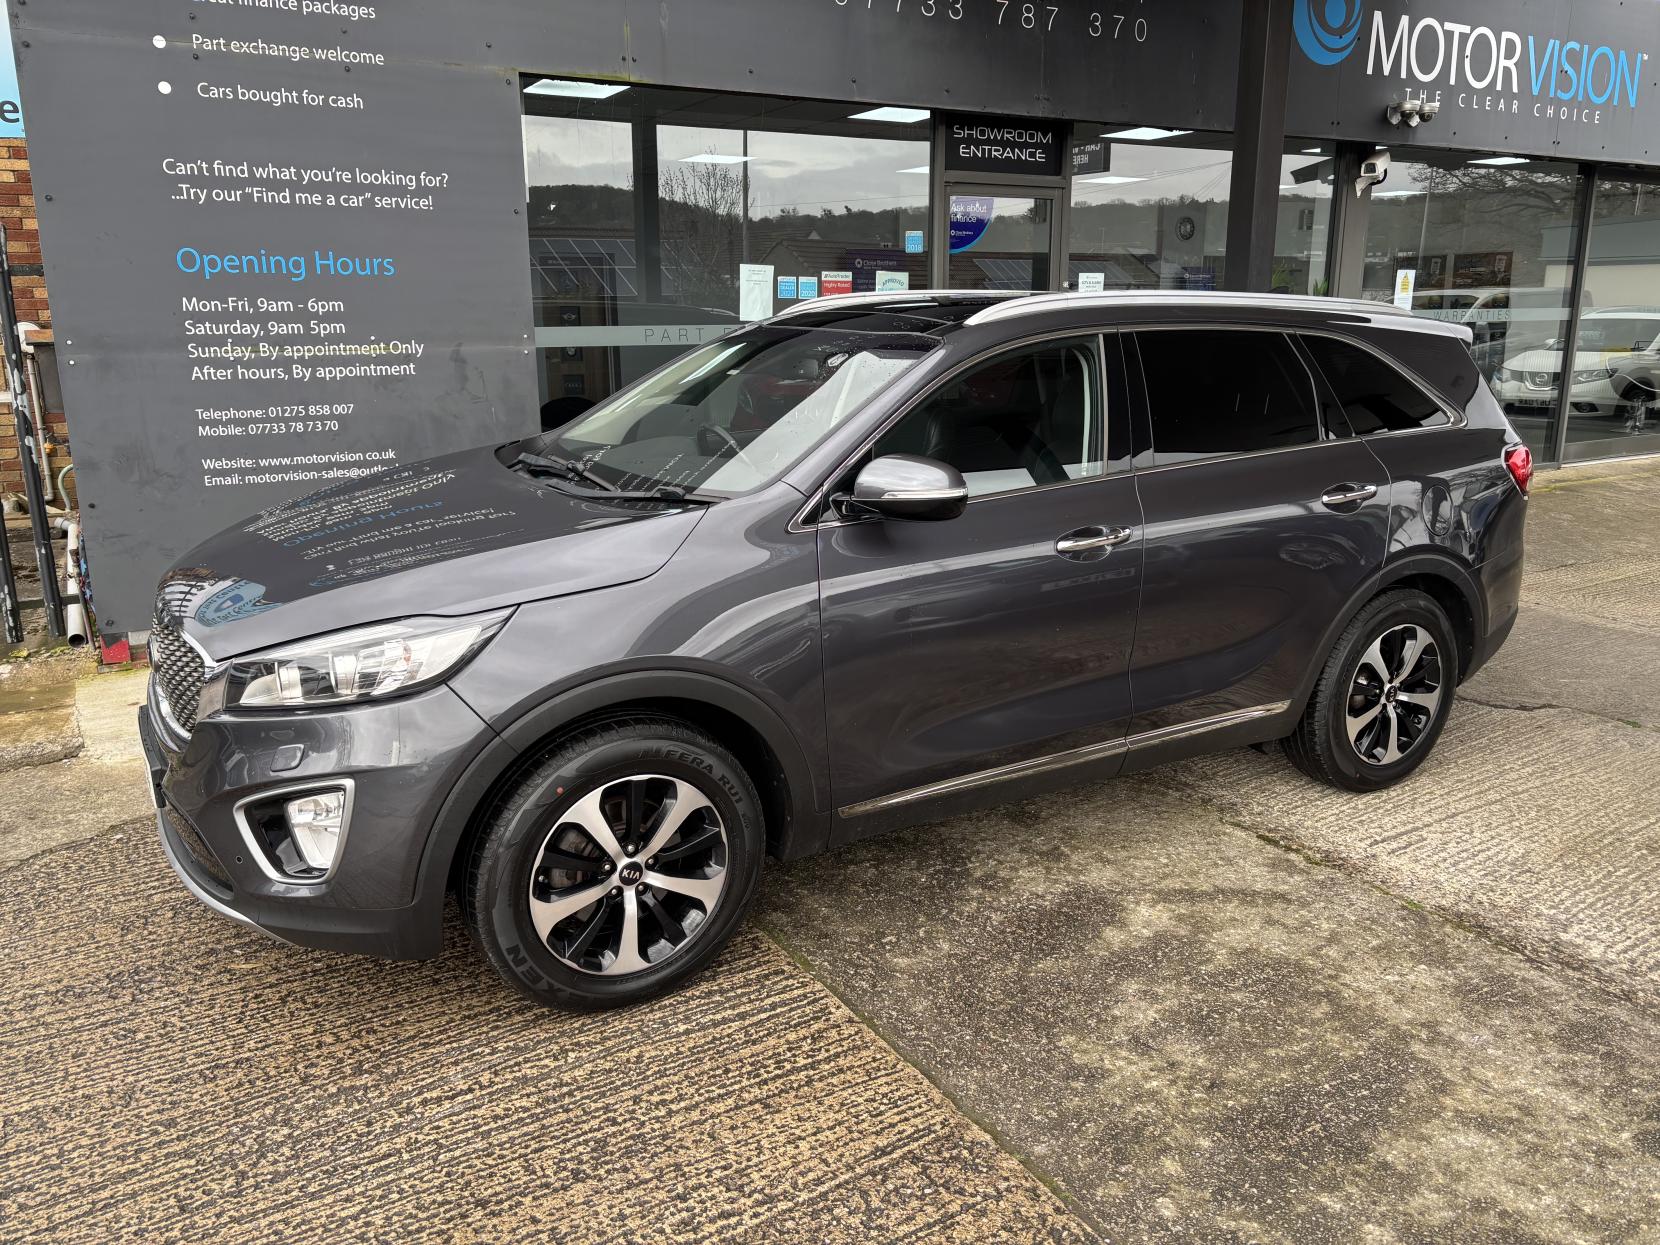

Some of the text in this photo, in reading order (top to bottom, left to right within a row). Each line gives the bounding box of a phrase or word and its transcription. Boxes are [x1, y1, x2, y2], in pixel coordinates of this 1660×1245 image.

[302, 0, 376, 21] packages
[997, 0, 1059, 31] 787
[1089, 13, 1147, 42] 370
[192, 33, 385, 66] Part exchange welcome
[196, 81, 364, 110] Cars bought for cash
[1405, 87, 1602, 125] THE CLEAR CHOICE
[953, 124, 1053, 145] SHOWROOM
[959, 144, 1046, 162] ENTRANCE
[162, 158, 449, 189] Can't find what you're looking for?
[211, 189, 243, 202] our
[295, 192, 322, 206] me
[326, 194, 336, 206] a
[374, 194, 434, 211] service!
[176, 247, 395, 281] Opening Hours
[182, 296, 254, 315] Mon-Fri,
[256, 298, 294, 313] 9am
[307, 298, 345, 316] 6pm
[185, 320, 346, 339] Saturday, 9am 5pm
[644, 327, 705, 343] PART
[187, 340, 425, 361] Sunday, By appointment Only
[191, 362, 417, 382] After hours, By appointment
[194, 403, 355, 422] Telephone: 01275 858 007
[198, 424, 247, 437] Mobile:
[248, 422, 286, 435] 07733
[201, 456, 257, 470] Website:
[204, 463, 399, 487] Email: motorvision-sales@outl
[621, 868, 640, 880] KIA
